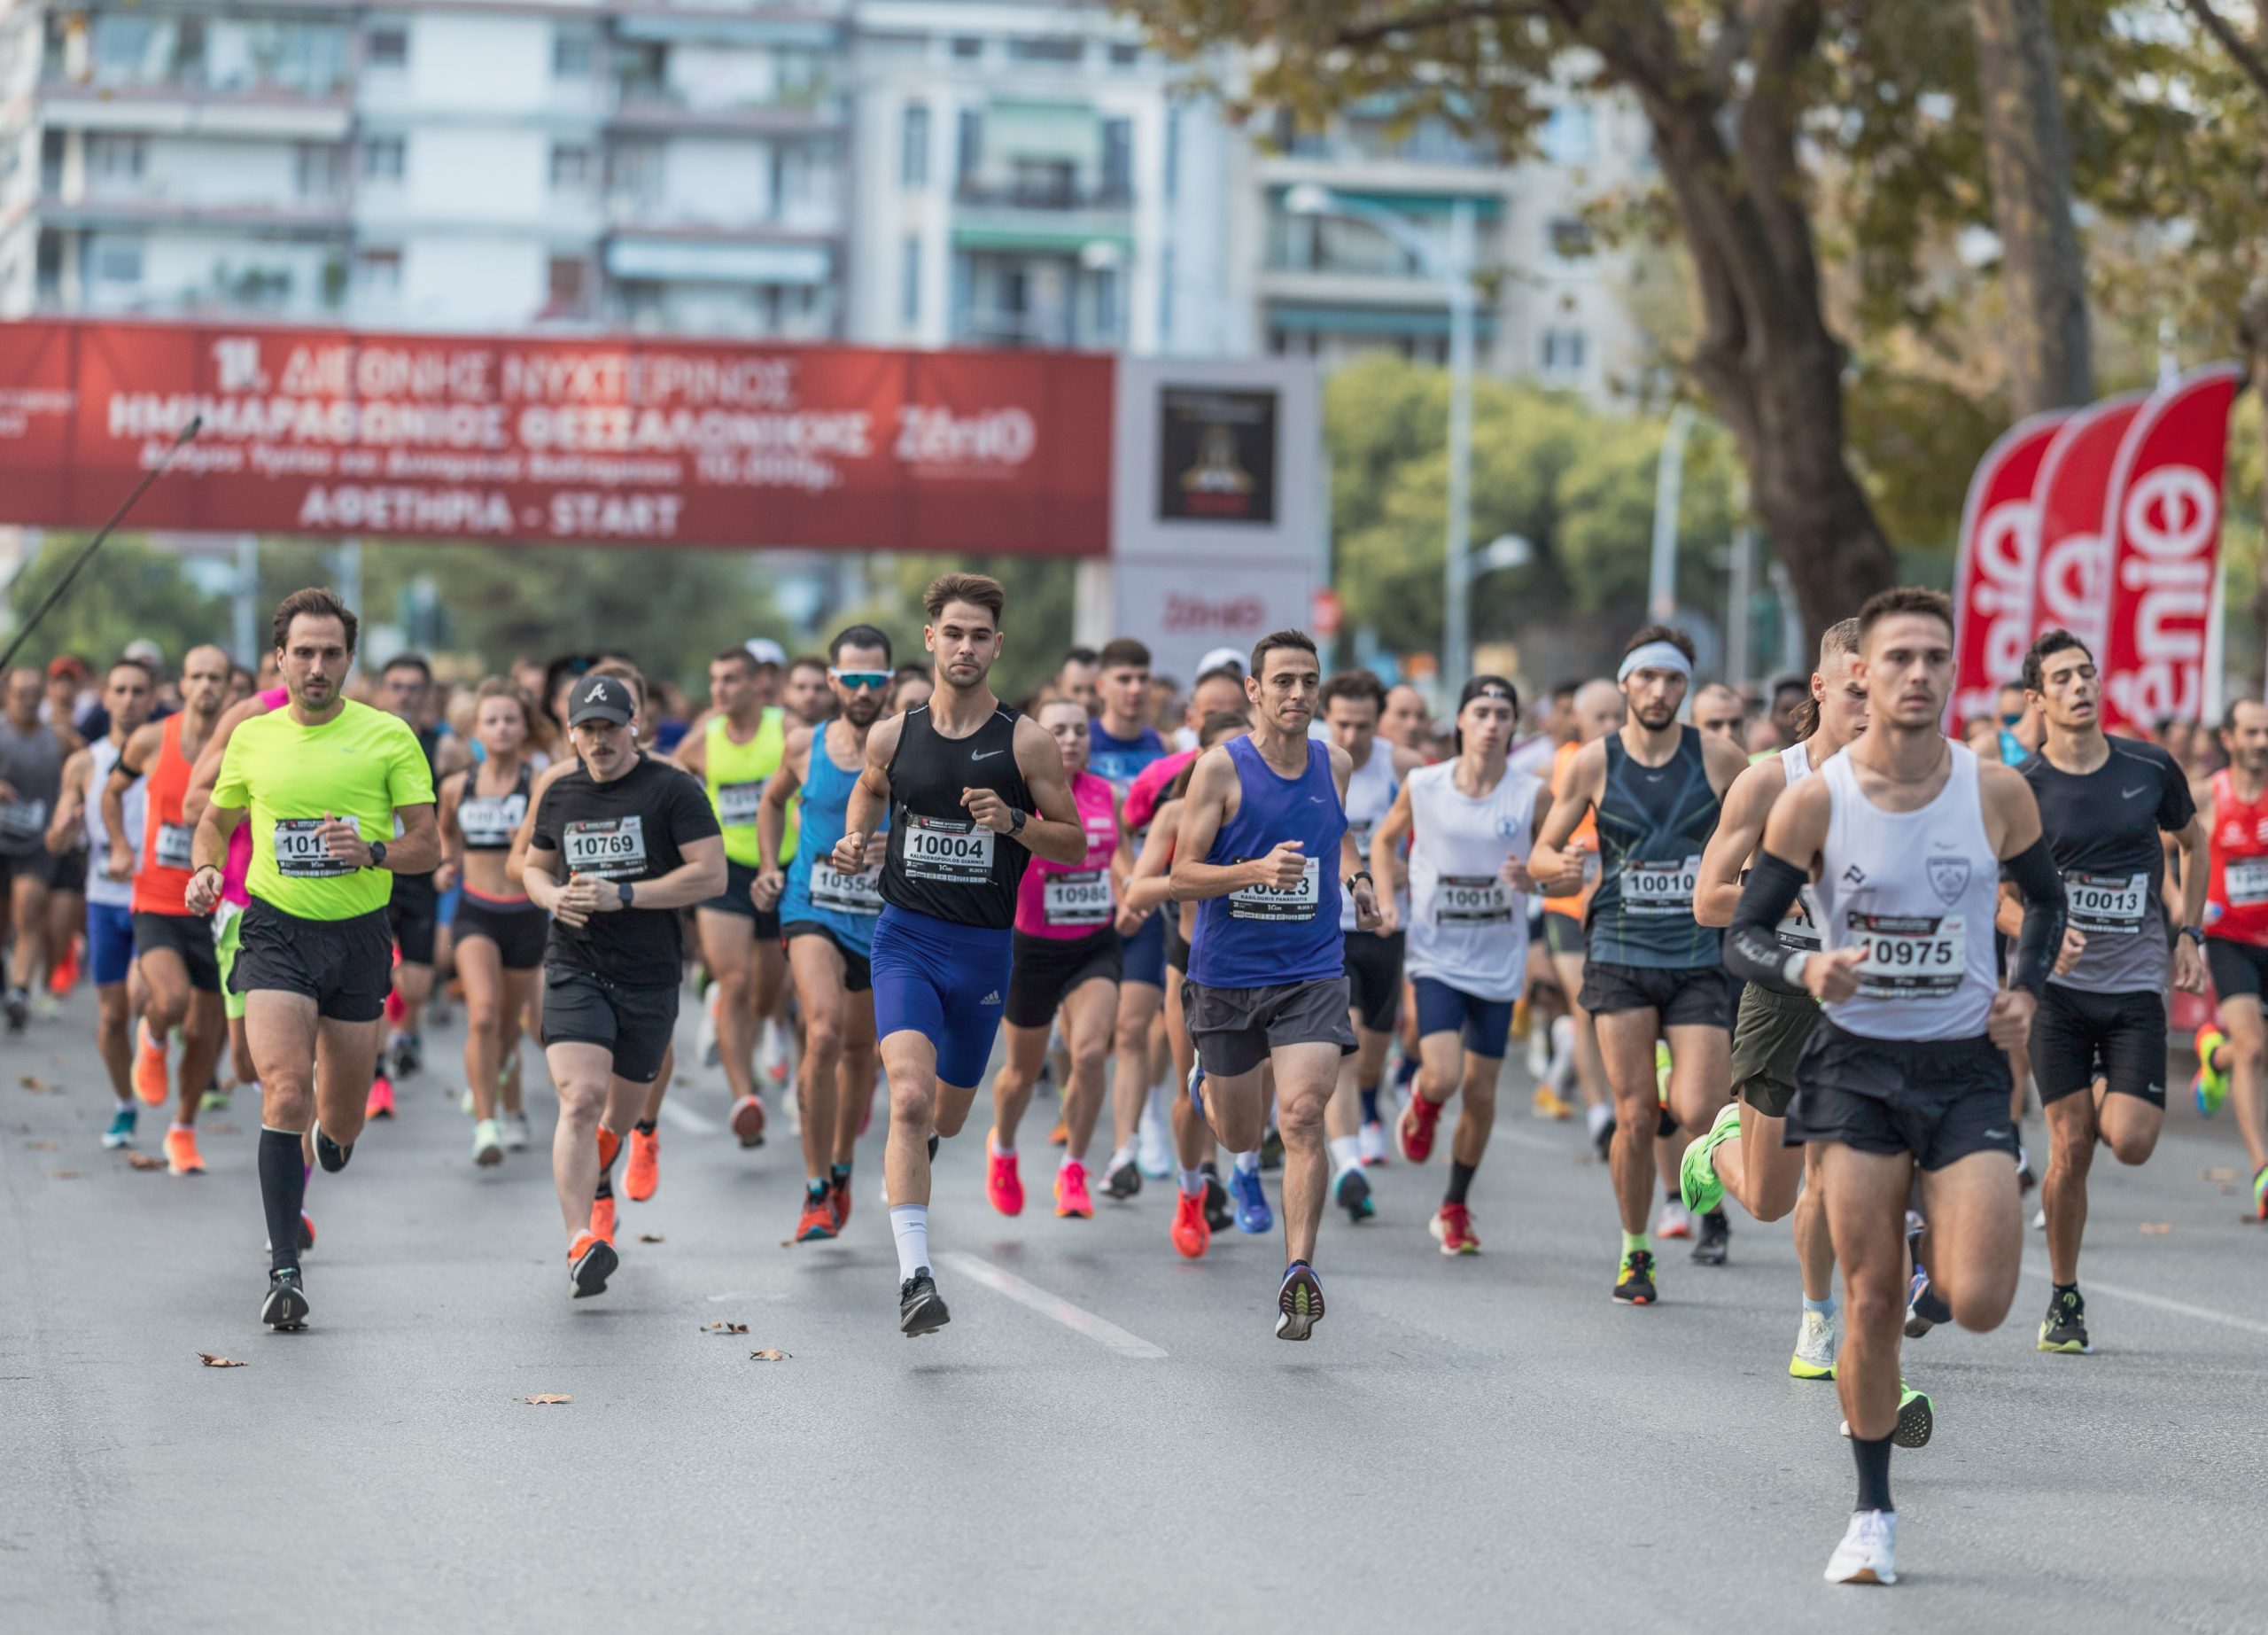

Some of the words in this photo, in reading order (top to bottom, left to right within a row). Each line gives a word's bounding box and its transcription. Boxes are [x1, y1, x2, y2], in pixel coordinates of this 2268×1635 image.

[549, 490, 682, 537] START
[584, 682, 608, 704] A
[573, 835, 634, 856] 10769
[914, 834, 983, 859] 10004
[1631, 874, 1695, 892] 10010
[2073, 889, 2138, 910] 10013
